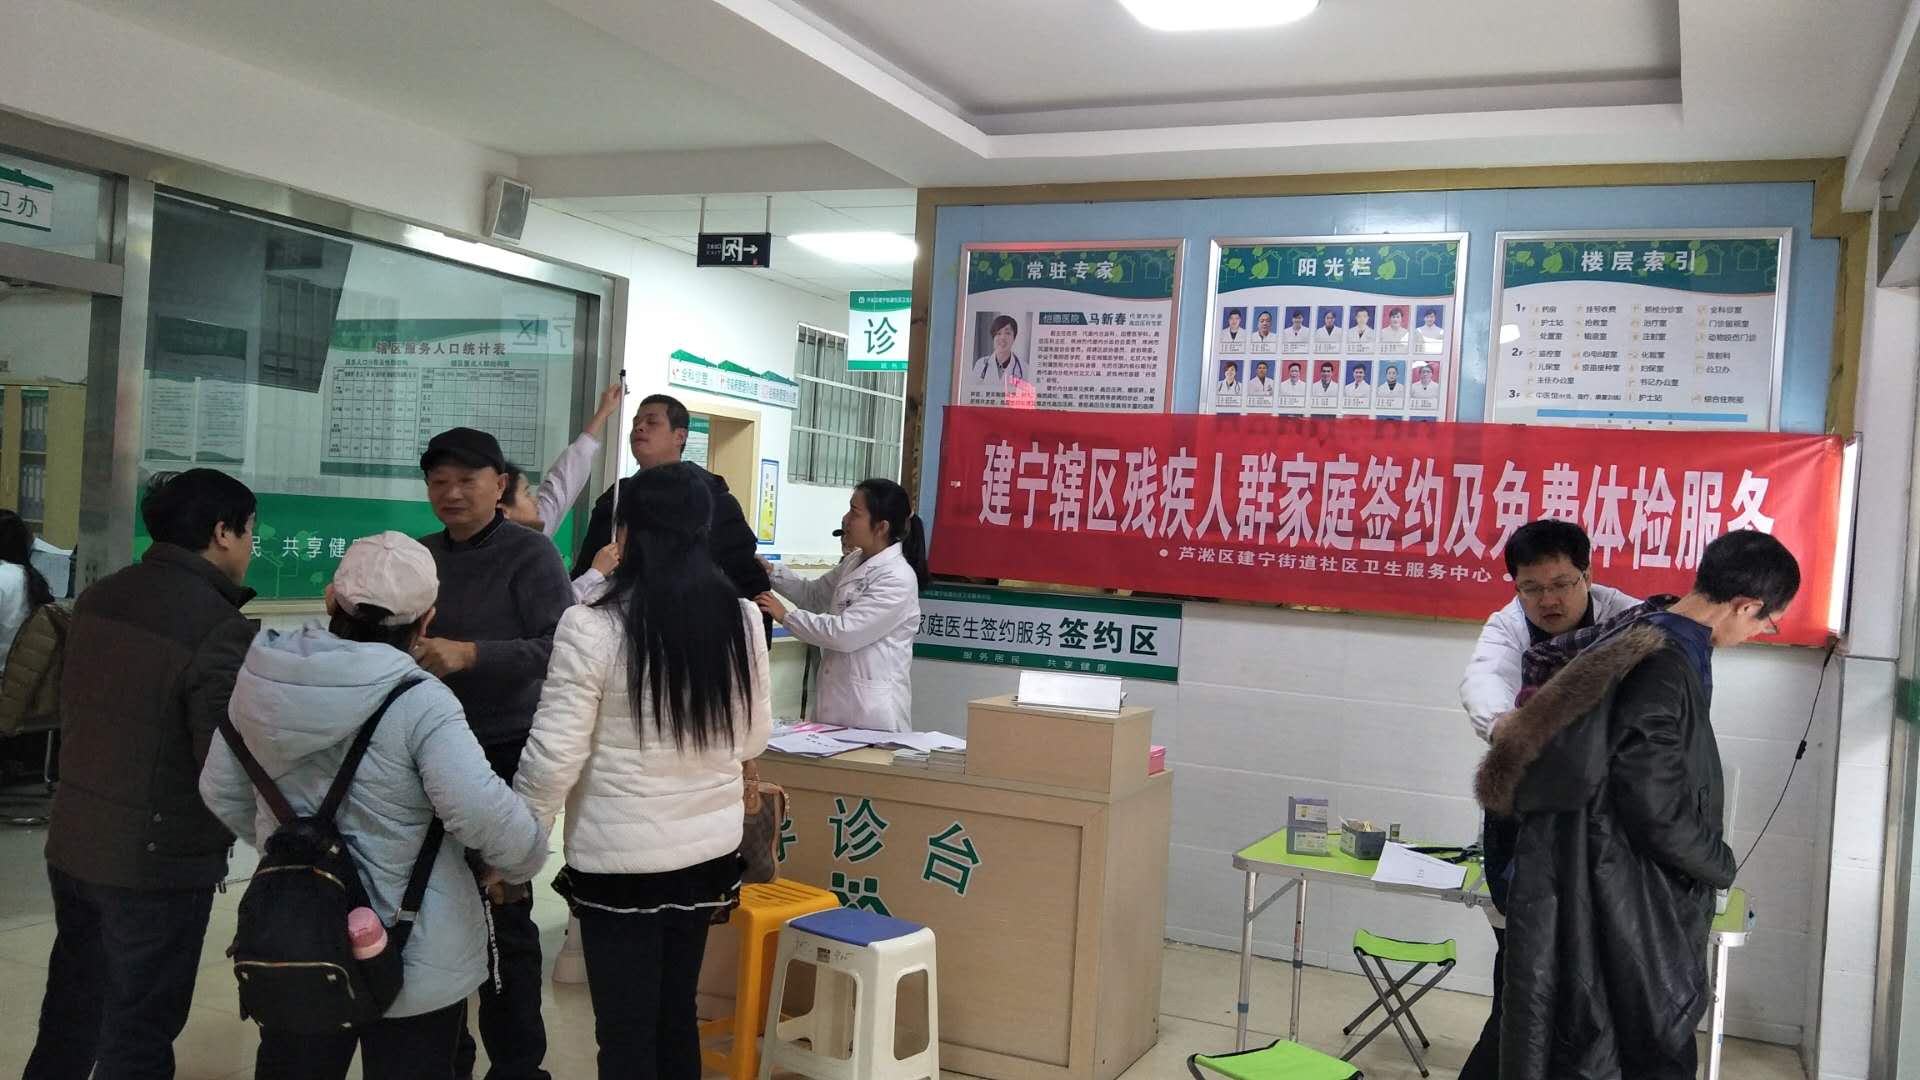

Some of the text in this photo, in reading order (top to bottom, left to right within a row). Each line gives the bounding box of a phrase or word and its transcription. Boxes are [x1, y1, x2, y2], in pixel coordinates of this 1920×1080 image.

[1026, 260, 1114, 280] 常驻专家
[1297, 256, 1372, 277] 阳光栏
[1581, 250, 1696, 273] 楼层索引
[1089, 312, 1127, 326] 马新春
[863, 317, 898, 355] 诊
[376, 341, 507, 357] 辖区服务人口统计表
[281, 536, 361, 559] 共享健
[1178, 545, 1493, 584] 芦淞区建宁街道社区卫生服务中心
[1058, 616, 1159, 657] 签约区
[962, 650, 1108, 673] 服务居民 共享健康
